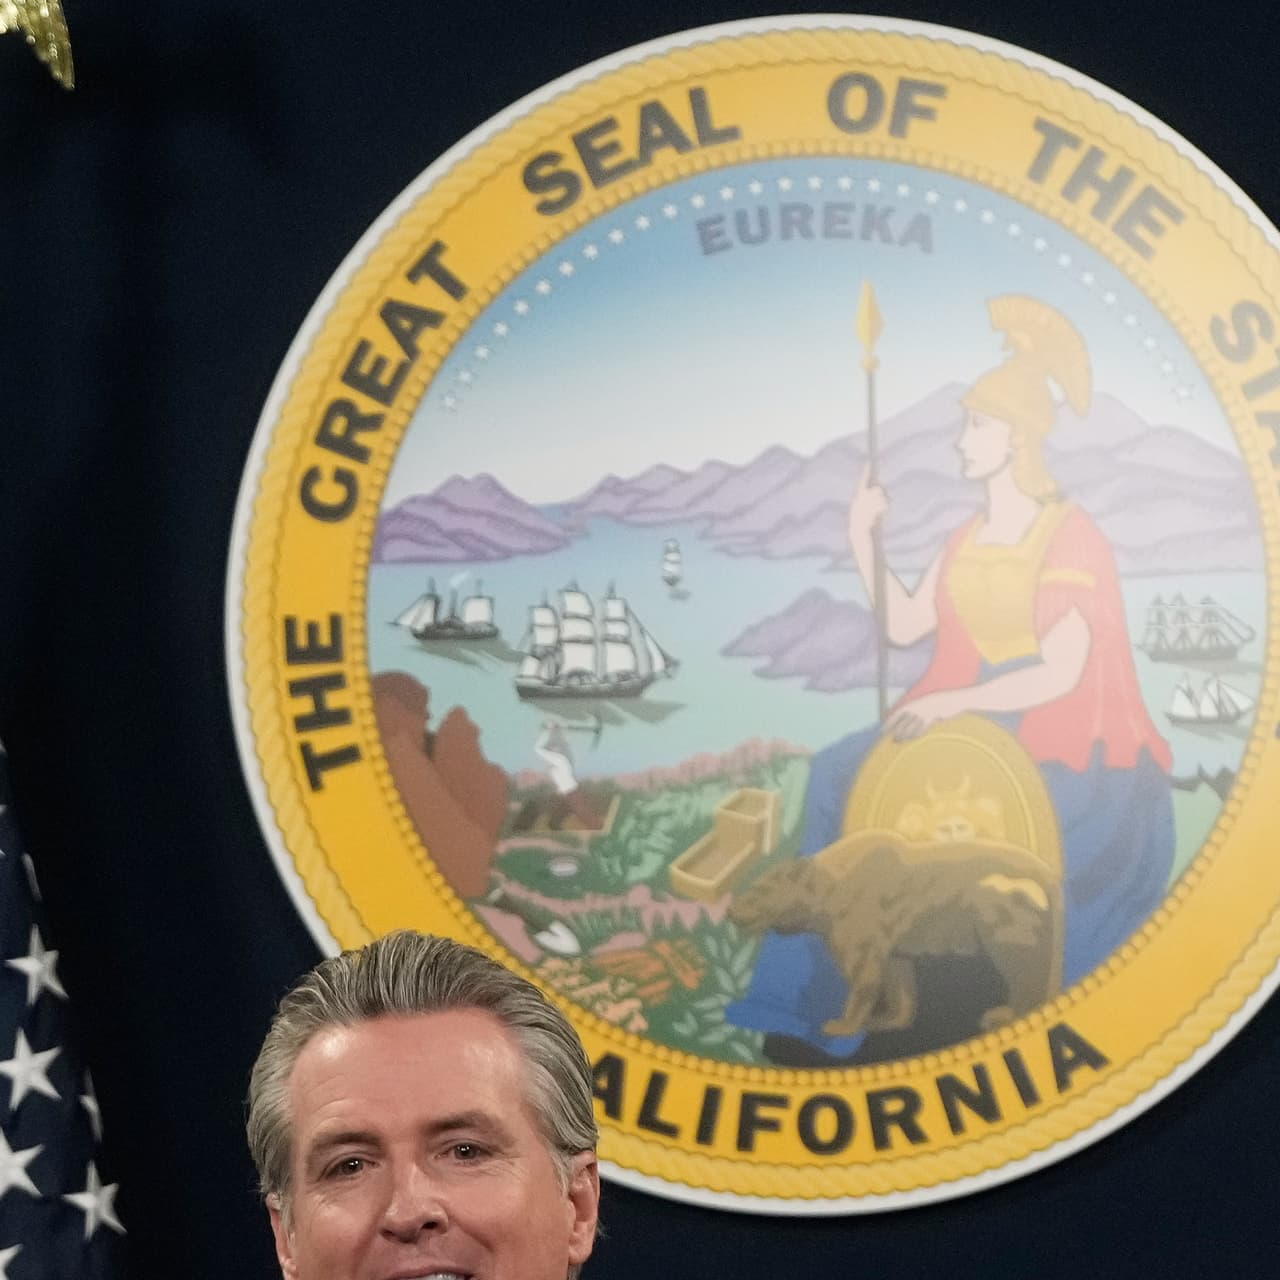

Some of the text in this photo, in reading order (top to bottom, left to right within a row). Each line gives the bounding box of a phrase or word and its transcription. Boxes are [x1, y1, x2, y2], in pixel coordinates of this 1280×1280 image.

[522, 87, 741, 217] SEAL
[825, 72, 948, 140] OF
[696, 202, 936, 258] EUREKA
[1030, 118, 1188, 262] THE
[299, 239, 470, 525] GREAT
[284, 613, 362, 792] THE
[591, 1022, 1111, 1155] ALIFORNIA
